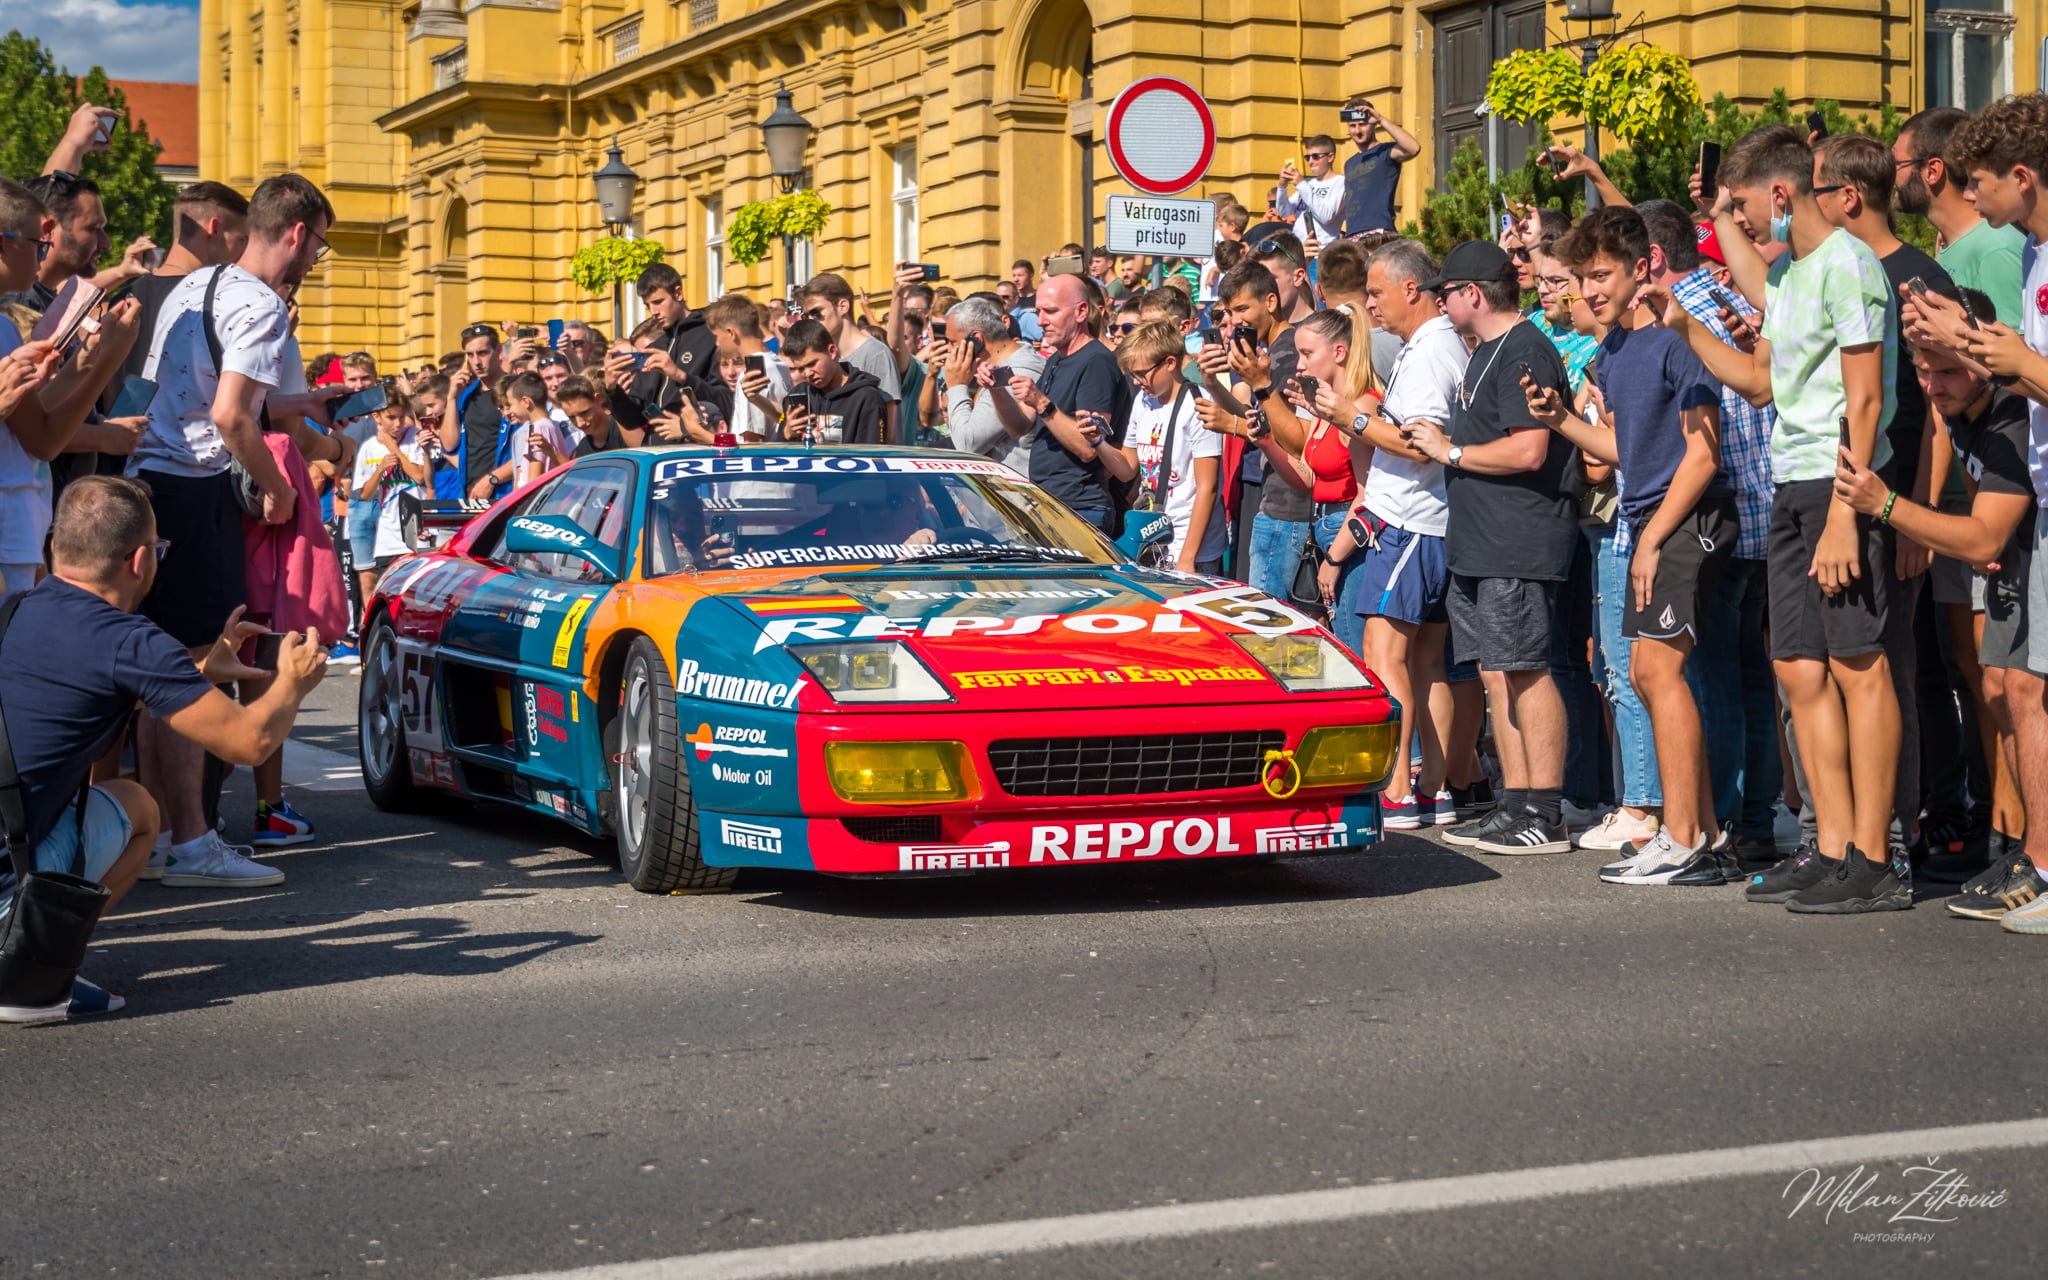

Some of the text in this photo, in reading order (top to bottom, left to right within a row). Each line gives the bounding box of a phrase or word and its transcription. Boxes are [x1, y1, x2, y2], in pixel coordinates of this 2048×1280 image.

[1124, 201, 1200, 225] Vatrogasni
[1136, 226, 1186, 250] pristup
[1137, 444, 1164, 463] MARVE
[662, 457, 1007, 479] REPSOL Ferrari
[458, 498, 492, 509] LAS
[652, 488, 670, 500] 3
[512, 518, 587, 547] REPSOL
[1139, 515, 1170, 540] REPSO
[885, 588, 1115, 600] Brummel
[753, 614, 1201, 655] REPSOL
[676, 658, 809, 709] Brummel
[951, 666, 1267, 689] Ferrari España
[402, 653, 435, 734] 57
[715, 726, 767, 744] REPSOL
[722, 767, 772, 786] Motor Oil
[721, 819, 782, 854] PIRELLI
[1029, 817, 1240, 862] REPSOL
[1255, 822, 1348, 854] PIRELLI
[898, 841, 1011, 871] PIRELLI
